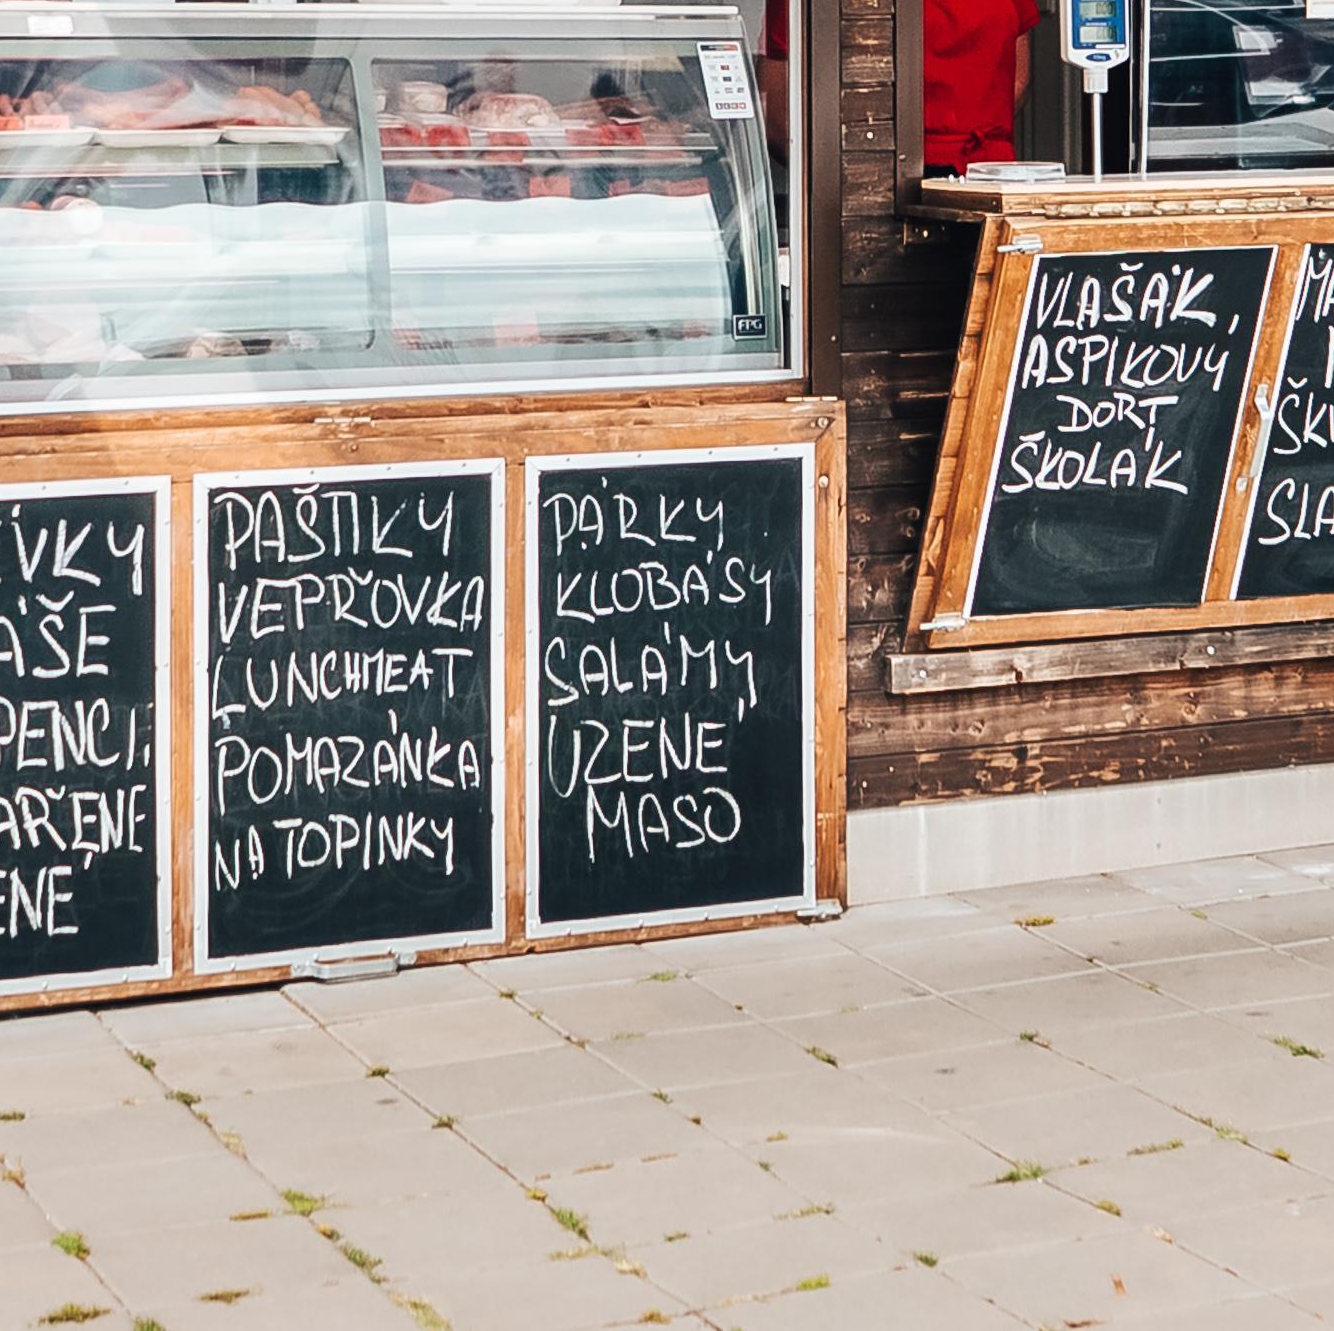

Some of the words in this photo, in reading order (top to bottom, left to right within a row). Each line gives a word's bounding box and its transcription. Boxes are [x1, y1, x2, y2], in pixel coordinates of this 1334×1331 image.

[1036, 262, 1218, 330] VLAŠÁK
[1056, 393, 1178, 433] DORT
[1001, 427, 1189, 495] ŠKOLÁK
[213, 483, 455, 570] PAŠTIKY
[542, 476, 725, 558] PÁRKY
[219, 567, 486, 644] VEPŘOVKA
[555, 550, 772, 625] KLOBÁSY
[212, 648, 474, 714] LUNCHMEAT
[544, 621, 758, 708] SALÁMY
[215, 709, 479, 814] POMAZÁNKA
[214, 837, 266, 892] NA
[272, 812, 455, 879] TOPINKY
[585, 785, 742, 864] MASO
